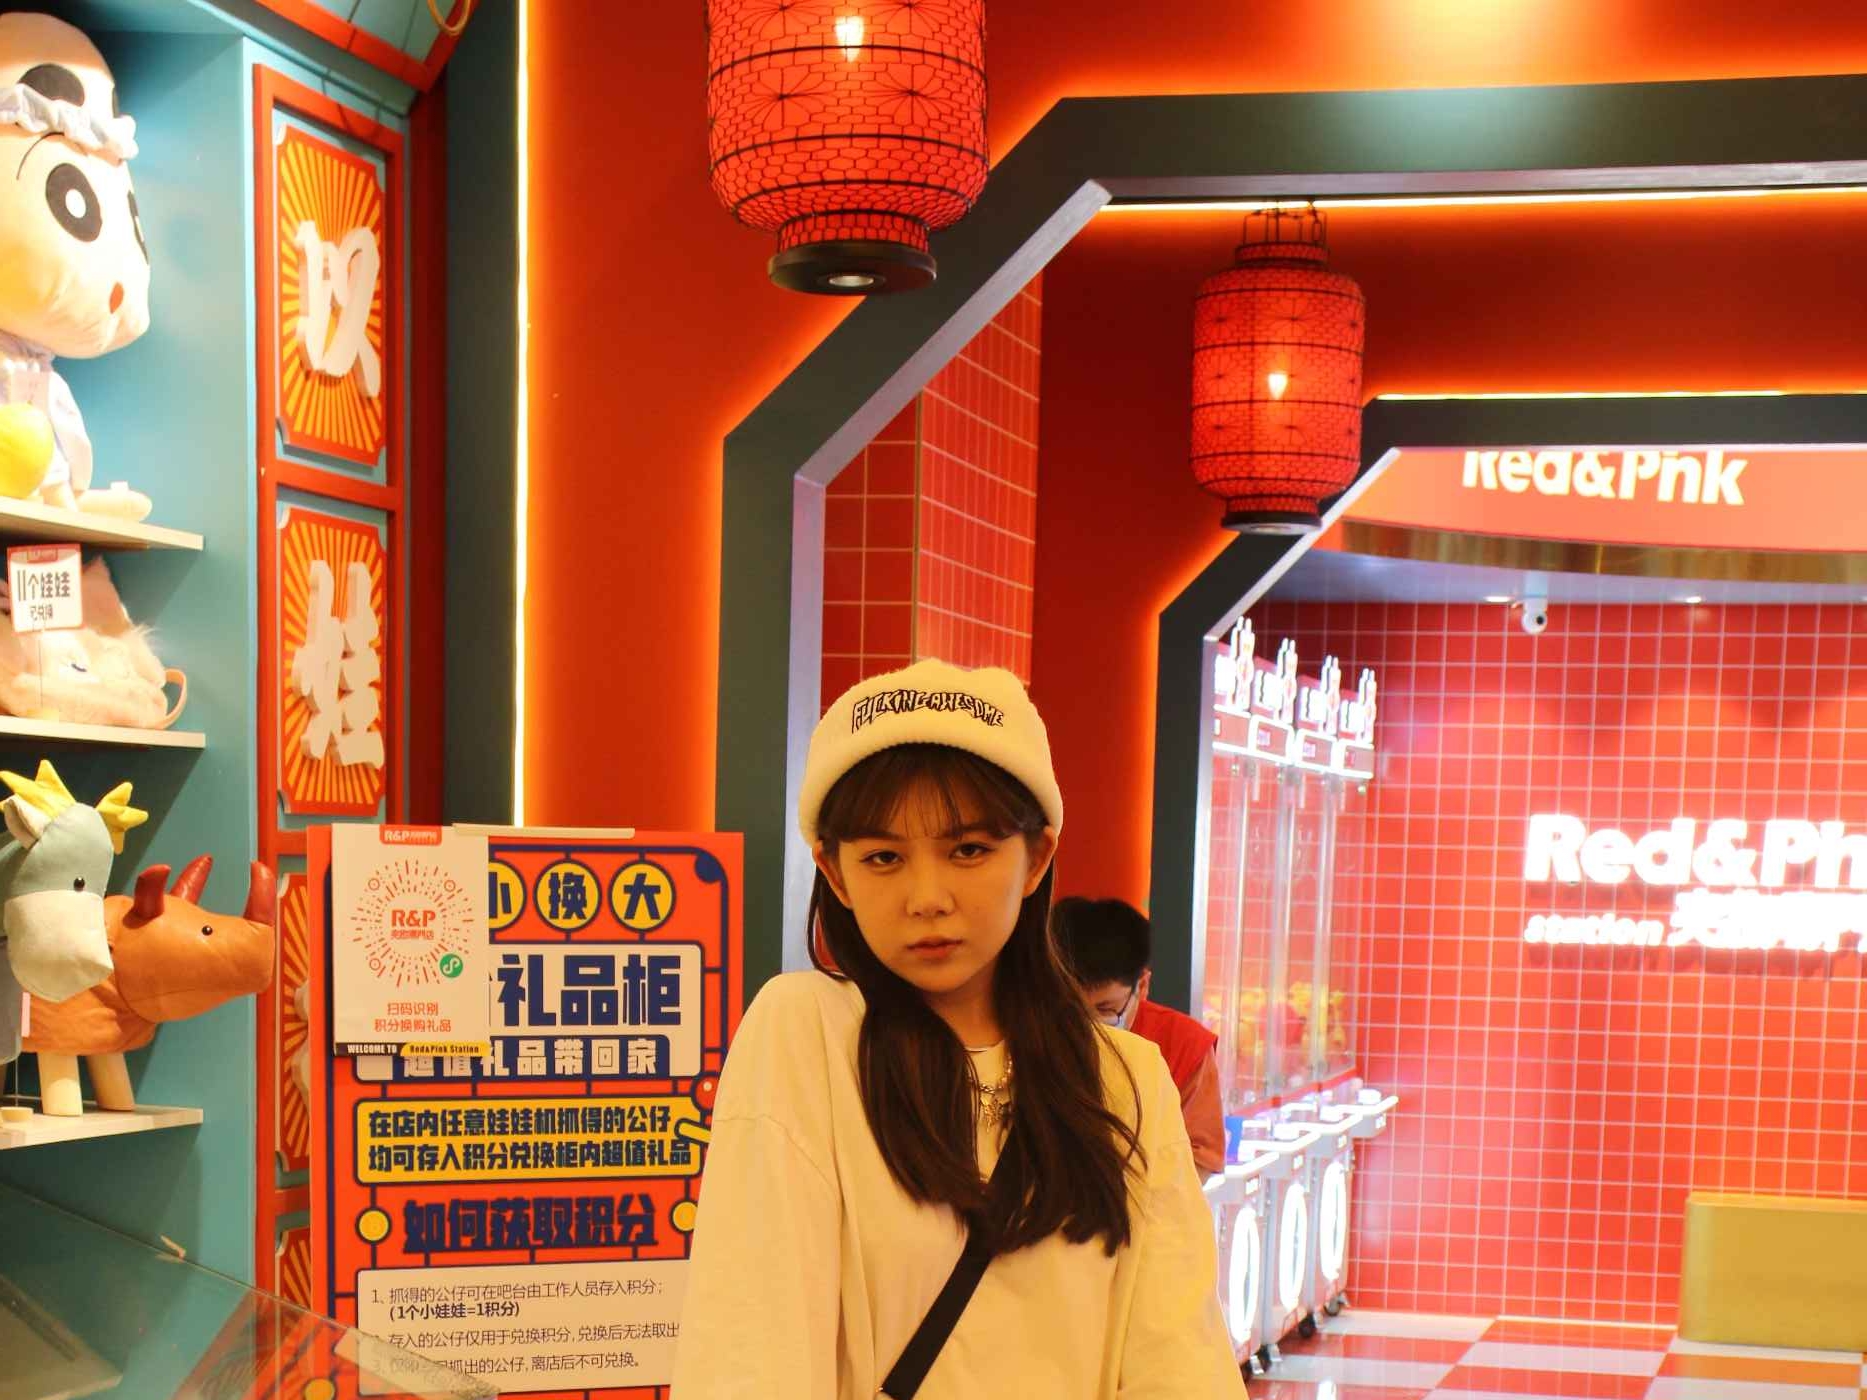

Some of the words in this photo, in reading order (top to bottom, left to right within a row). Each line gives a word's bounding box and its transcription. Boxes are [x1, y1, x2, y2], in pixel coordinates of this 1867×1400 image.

[929, 691, 1004, 728] AWESOME
[391, 909, 436, 928] R&P
[490, 953, 681, 1027] 礼品柜
[387, 1002, 439, 1016] 扫码识别
[374, 1018, 452, 1033] 积分换购礼品
[347, 1044, 385, 1054] WELCOME
[386, 1044, 398, 1054] TO
[449, 1044, 480, 1054] Station
[368, 1105, 671, 1138] 在店内任意娃娃机抓得的公仔
[368, 1139, 691, 1172] 均可存入积分兑换柜内超值礼品
[403, 1193, 659, 1254] 如何获取积分
